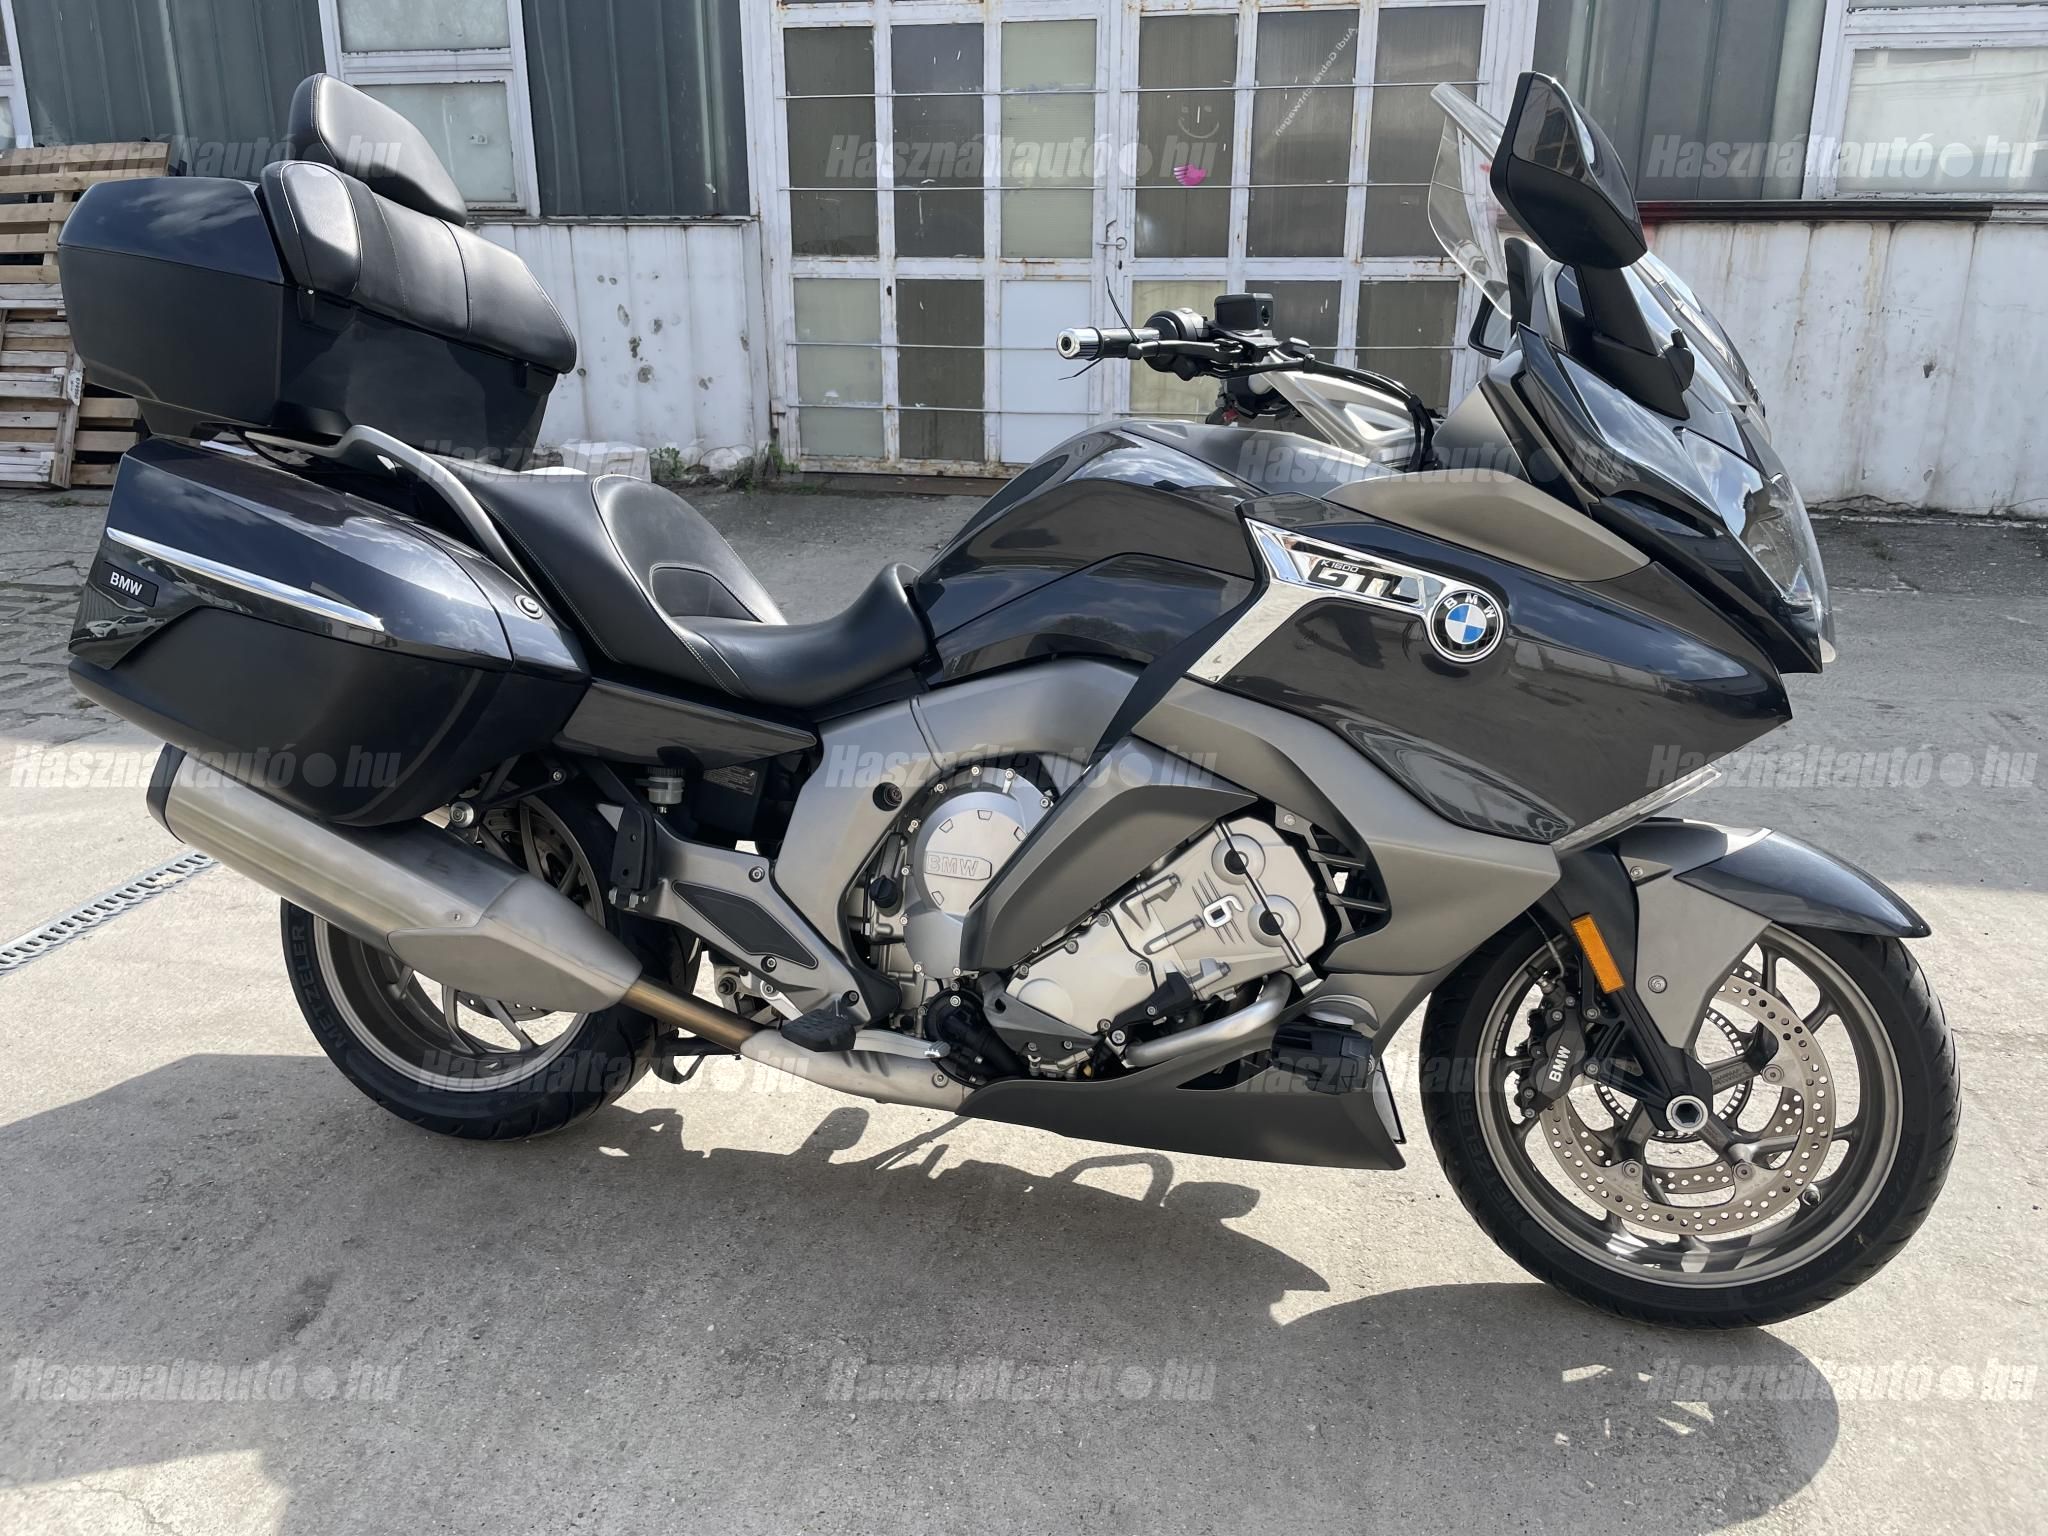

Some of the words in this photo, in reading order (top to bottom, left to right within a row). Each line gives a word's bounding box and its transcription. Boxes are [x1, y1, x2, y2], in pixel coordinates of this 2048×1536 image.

[110, 571, 143, 596] BMW
[1444, 592, 1496, 618] BMW
[926, 854, 980, 877] BMW
[292, 926, 346, 1048] METZELER
[1549, 1045, 1571, 1082] BMW
